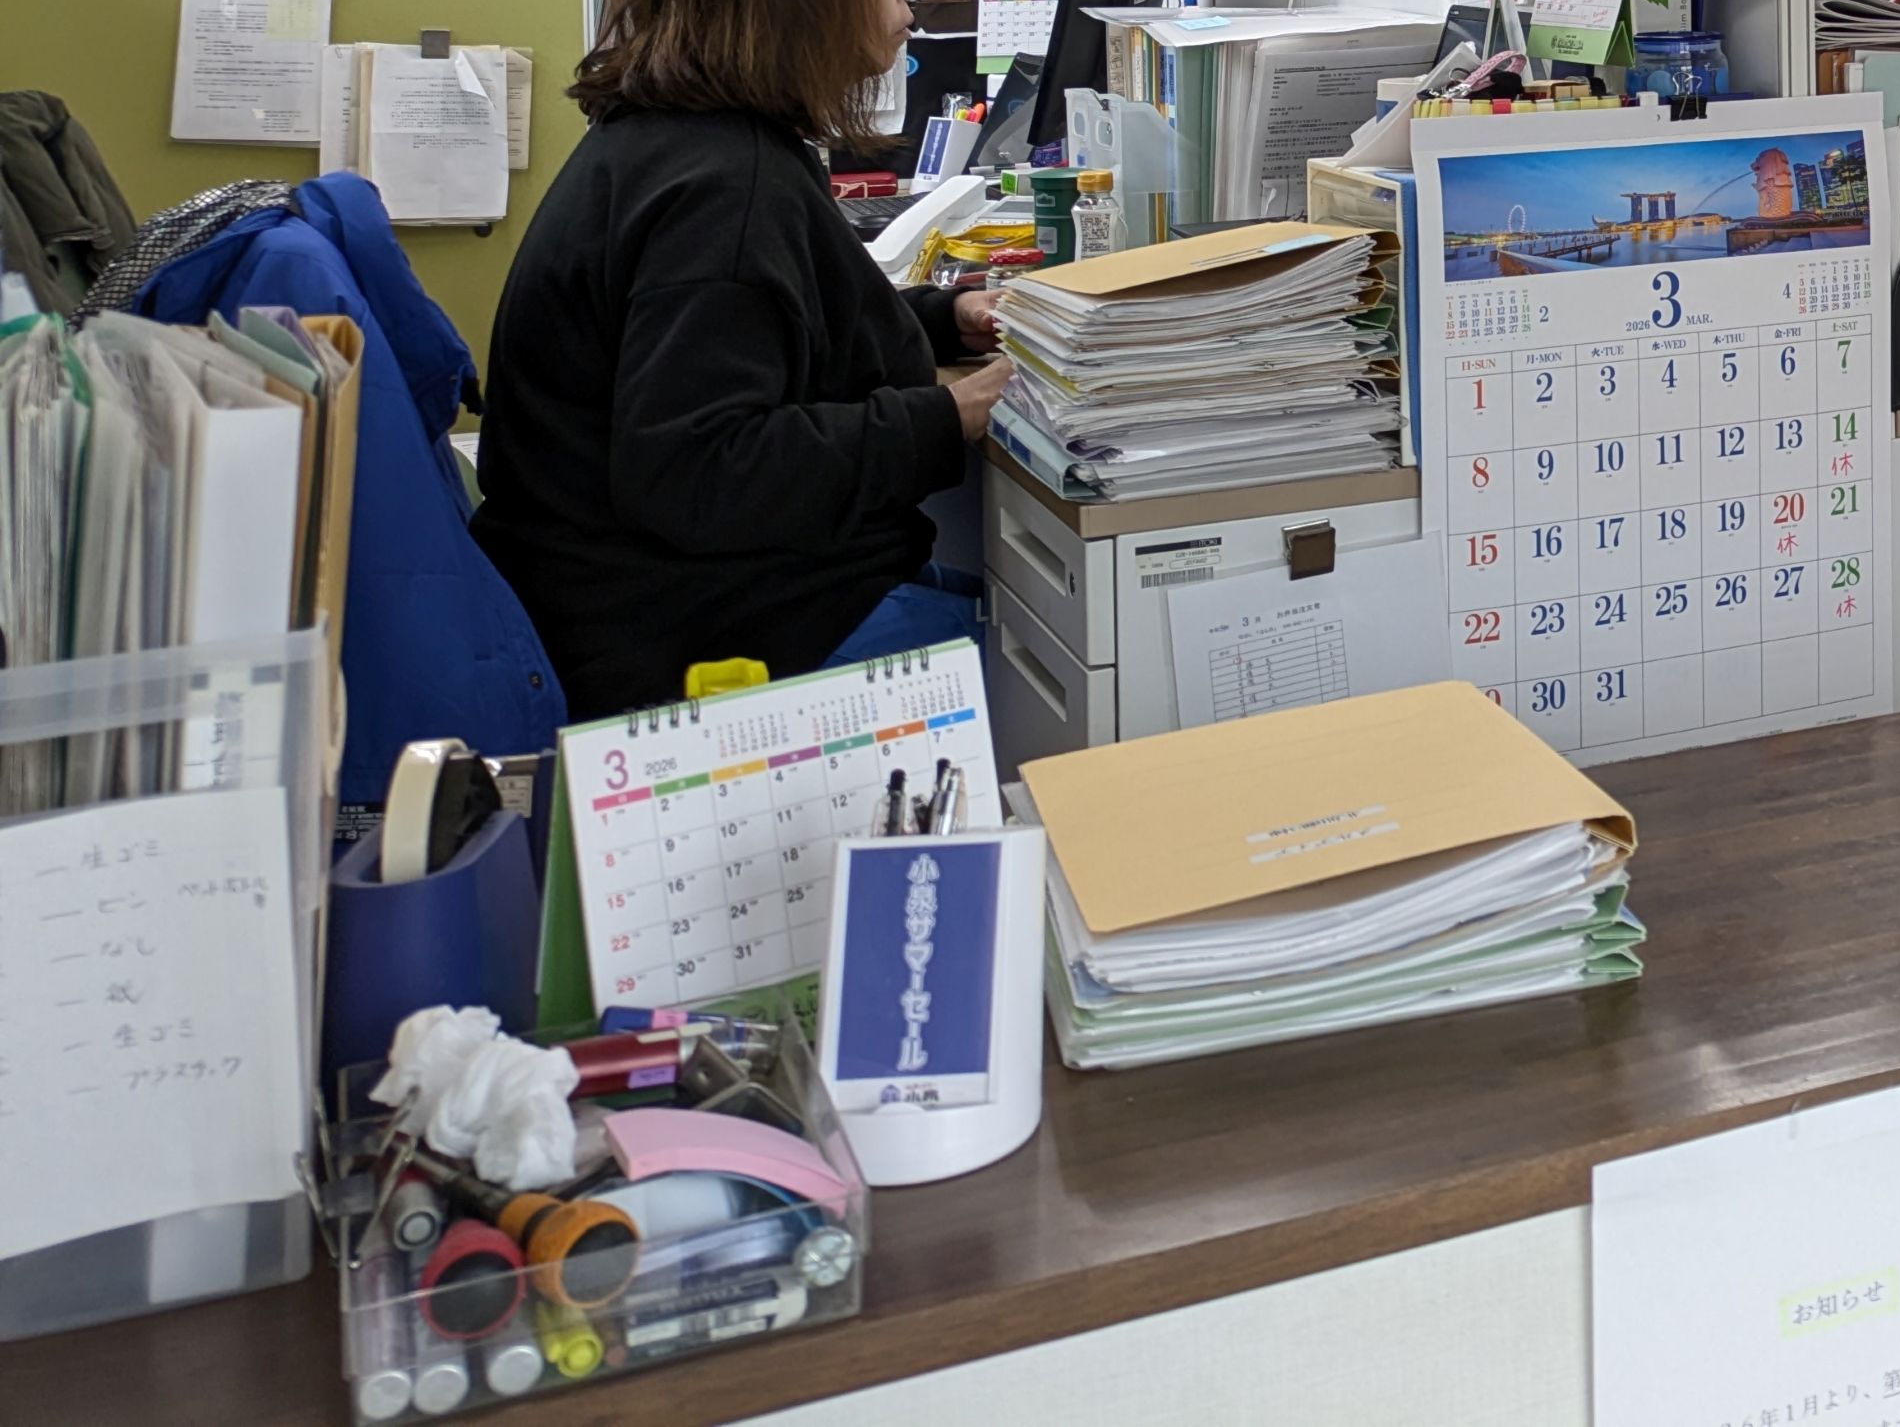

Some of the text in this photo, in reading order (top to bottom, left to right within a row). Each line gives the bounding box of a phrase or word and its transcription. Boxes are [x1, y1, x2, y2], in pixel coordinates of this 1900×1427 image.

[1652, 271, 1682, 329] 3
[1783, 283, 1791, 299] 4
[1798, 281, 1871, 296] 12 13 14 15 16 17 18
[1831, 291, 1851, 302] 22 23
[1446, 313, 1531, 330] 15 16 17 18 19 20 21
[1459, 304, 1531, 319] 9 10 11 12 13 14
[1539, 305, 1549, 323] 2
[1625, 314, 1713, 332] 2026 MAR.
[1445, 323, 1532, 340] 22 23 24 25 26 27 28
[1473, 340, 1852, 409] 1 2 3 4 5 6 7
[1472, 412, 1858, 487] 8 9 10 11 12 13 14
[1831, 452, 1855, 477] 休
[1466, 484, 1858, 566] 15 16 17 18 19 20 21
[1776, 531, 1799, 558] 休
[1464, 557, 1860, 644] 22 23 24 25 26 27 28
[1836, 595, 1859, 619] 休
[1242, 616, 1249, 627] 3
[1532, 669, 1627, 712] 30 31
[601, 731, 940, 826] 1 2 3 4 5 6 7
[604, 749, 678, 791] 3 2026
[605, 794, 848, 867] 8 9 10 11 12
[608, 848, 799, 909] 15 16 17 18
[612, 887, 804, 952] 22 23 24 25
[617, 944, 751, 994] 29 30 31
[112, 1019, 195, 1049] 生ゴミ
[1792, 1280, 1885, 1325] お知らせ
